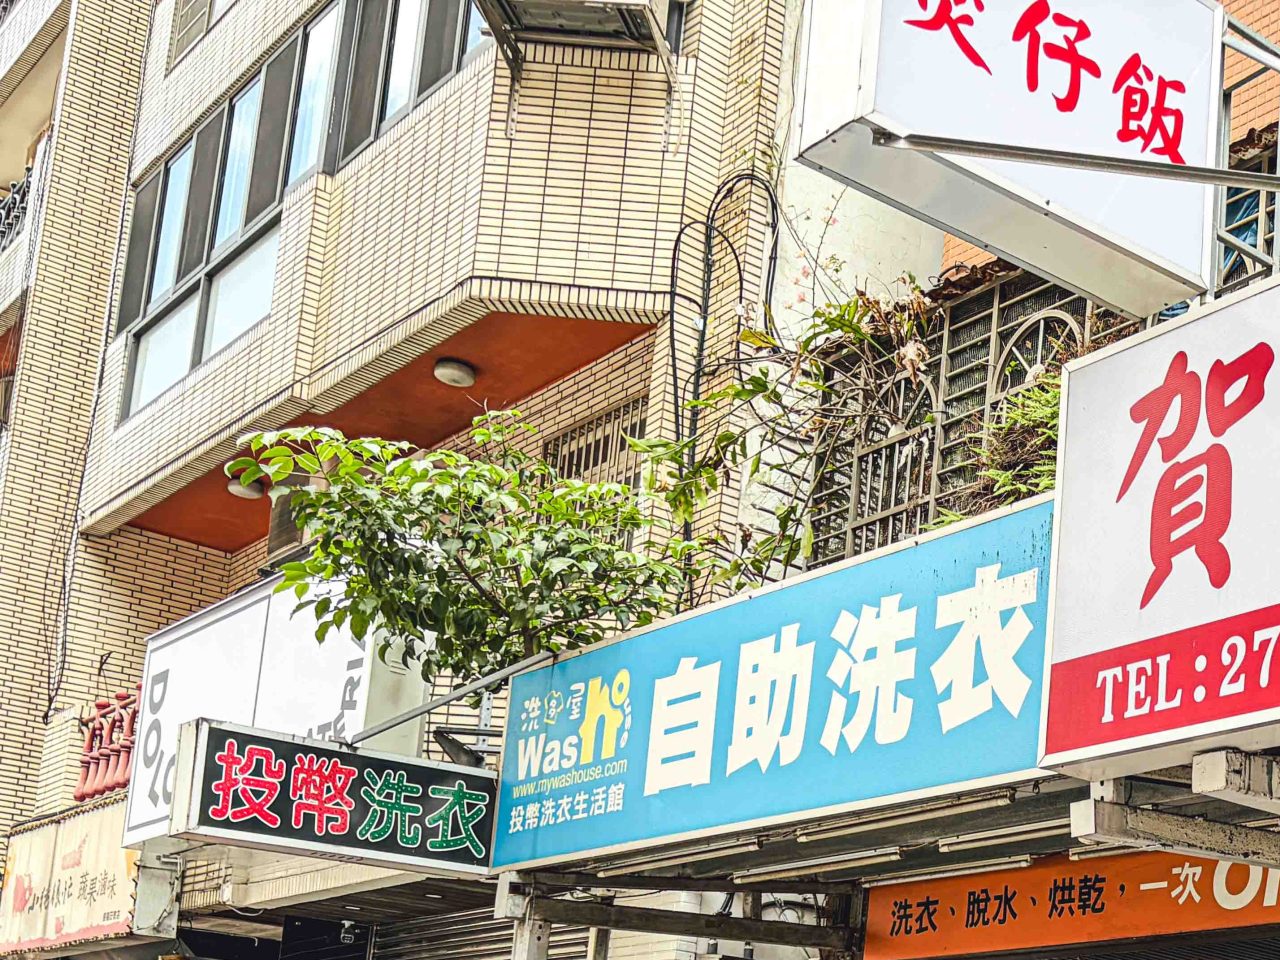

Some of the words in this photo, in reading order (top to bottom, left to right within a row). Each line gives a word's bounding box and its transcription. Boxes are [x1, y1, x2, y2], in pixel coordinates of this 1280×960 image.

[643, 563, 1039, 797] 自助洗衣
[209, 738, 489, 859] 投幣洗衣
[508, 782, 626, 834] 投幣洗衣生活館
[512, 759, 628, 800] www.mywashouse.com
